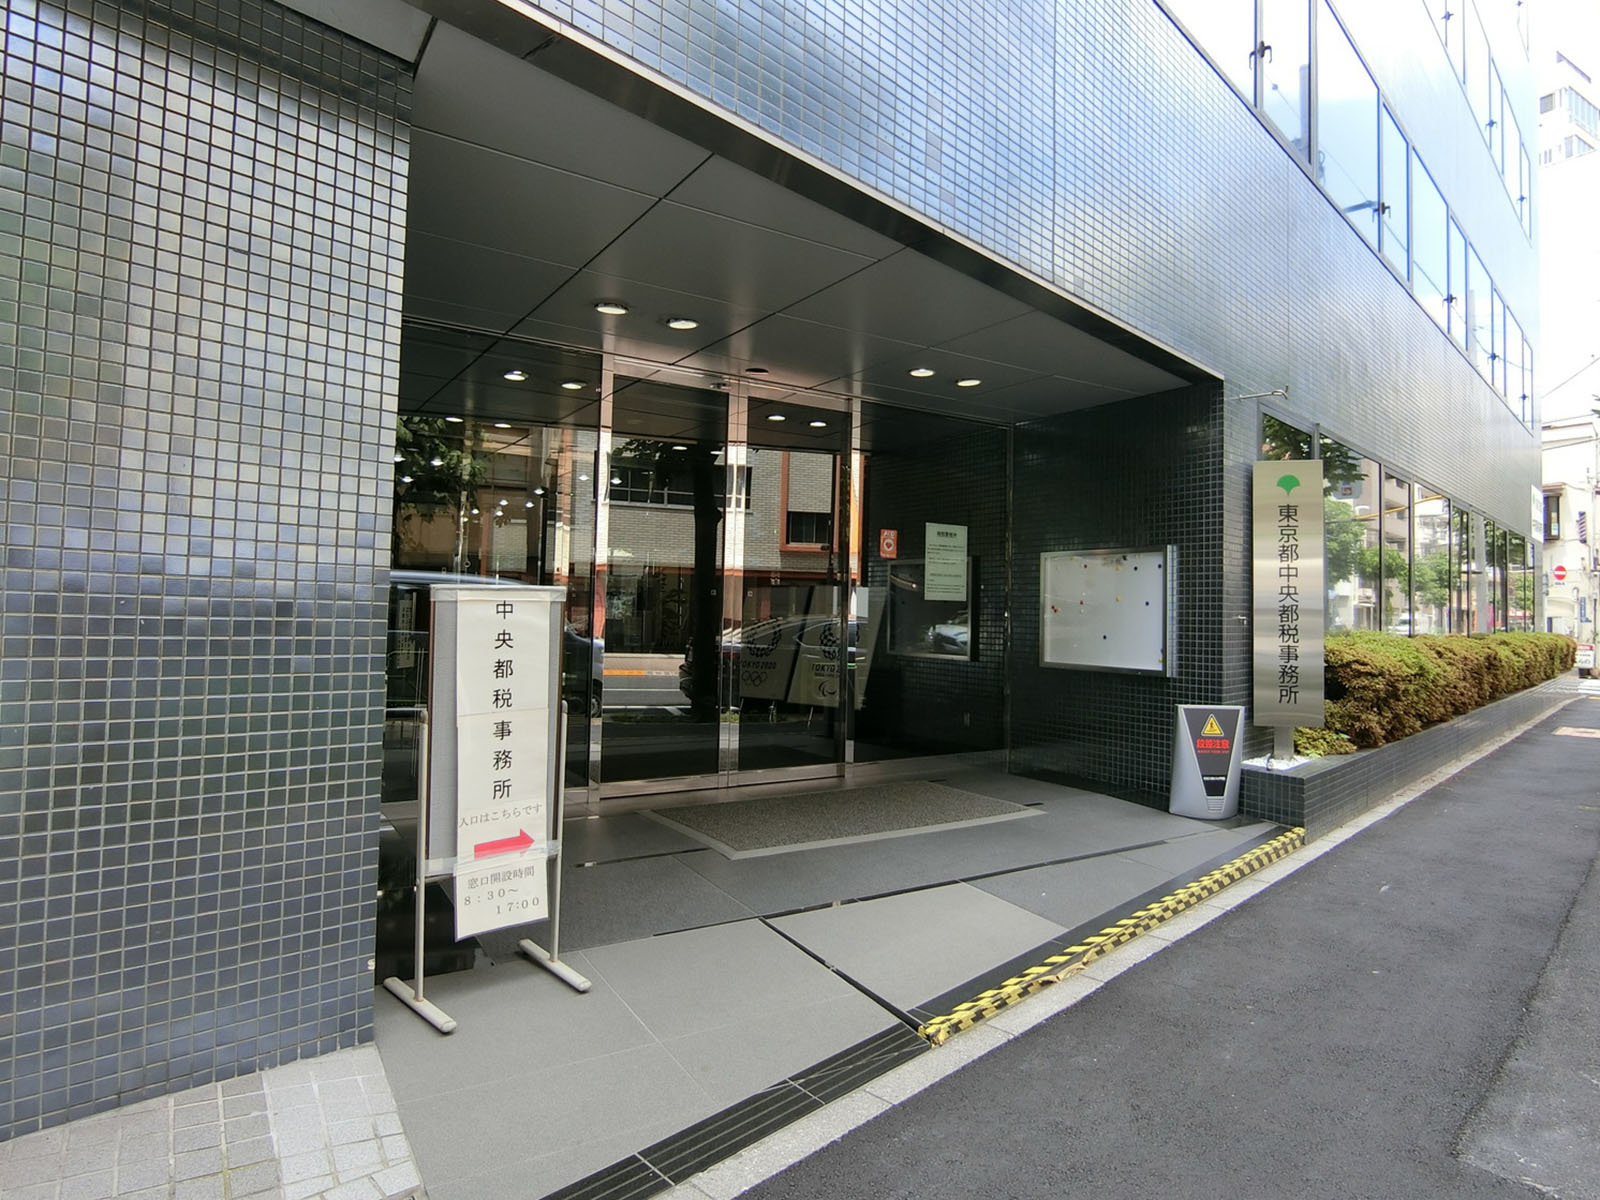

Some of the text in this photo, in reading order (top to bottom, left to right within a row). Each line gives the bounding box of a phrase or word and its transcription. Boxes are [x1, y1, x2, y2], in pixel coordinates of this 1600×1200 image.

[1278, 504, 1299, 704] 東京都中央都税事務所
[811, 663, 835, 673] TOKYO
[492, 600, 514, 800] 中央都税事務所
[458, 803, 543, 828] 入口はこちらです
[467, 865, 535, 889] 窓口開設時間
